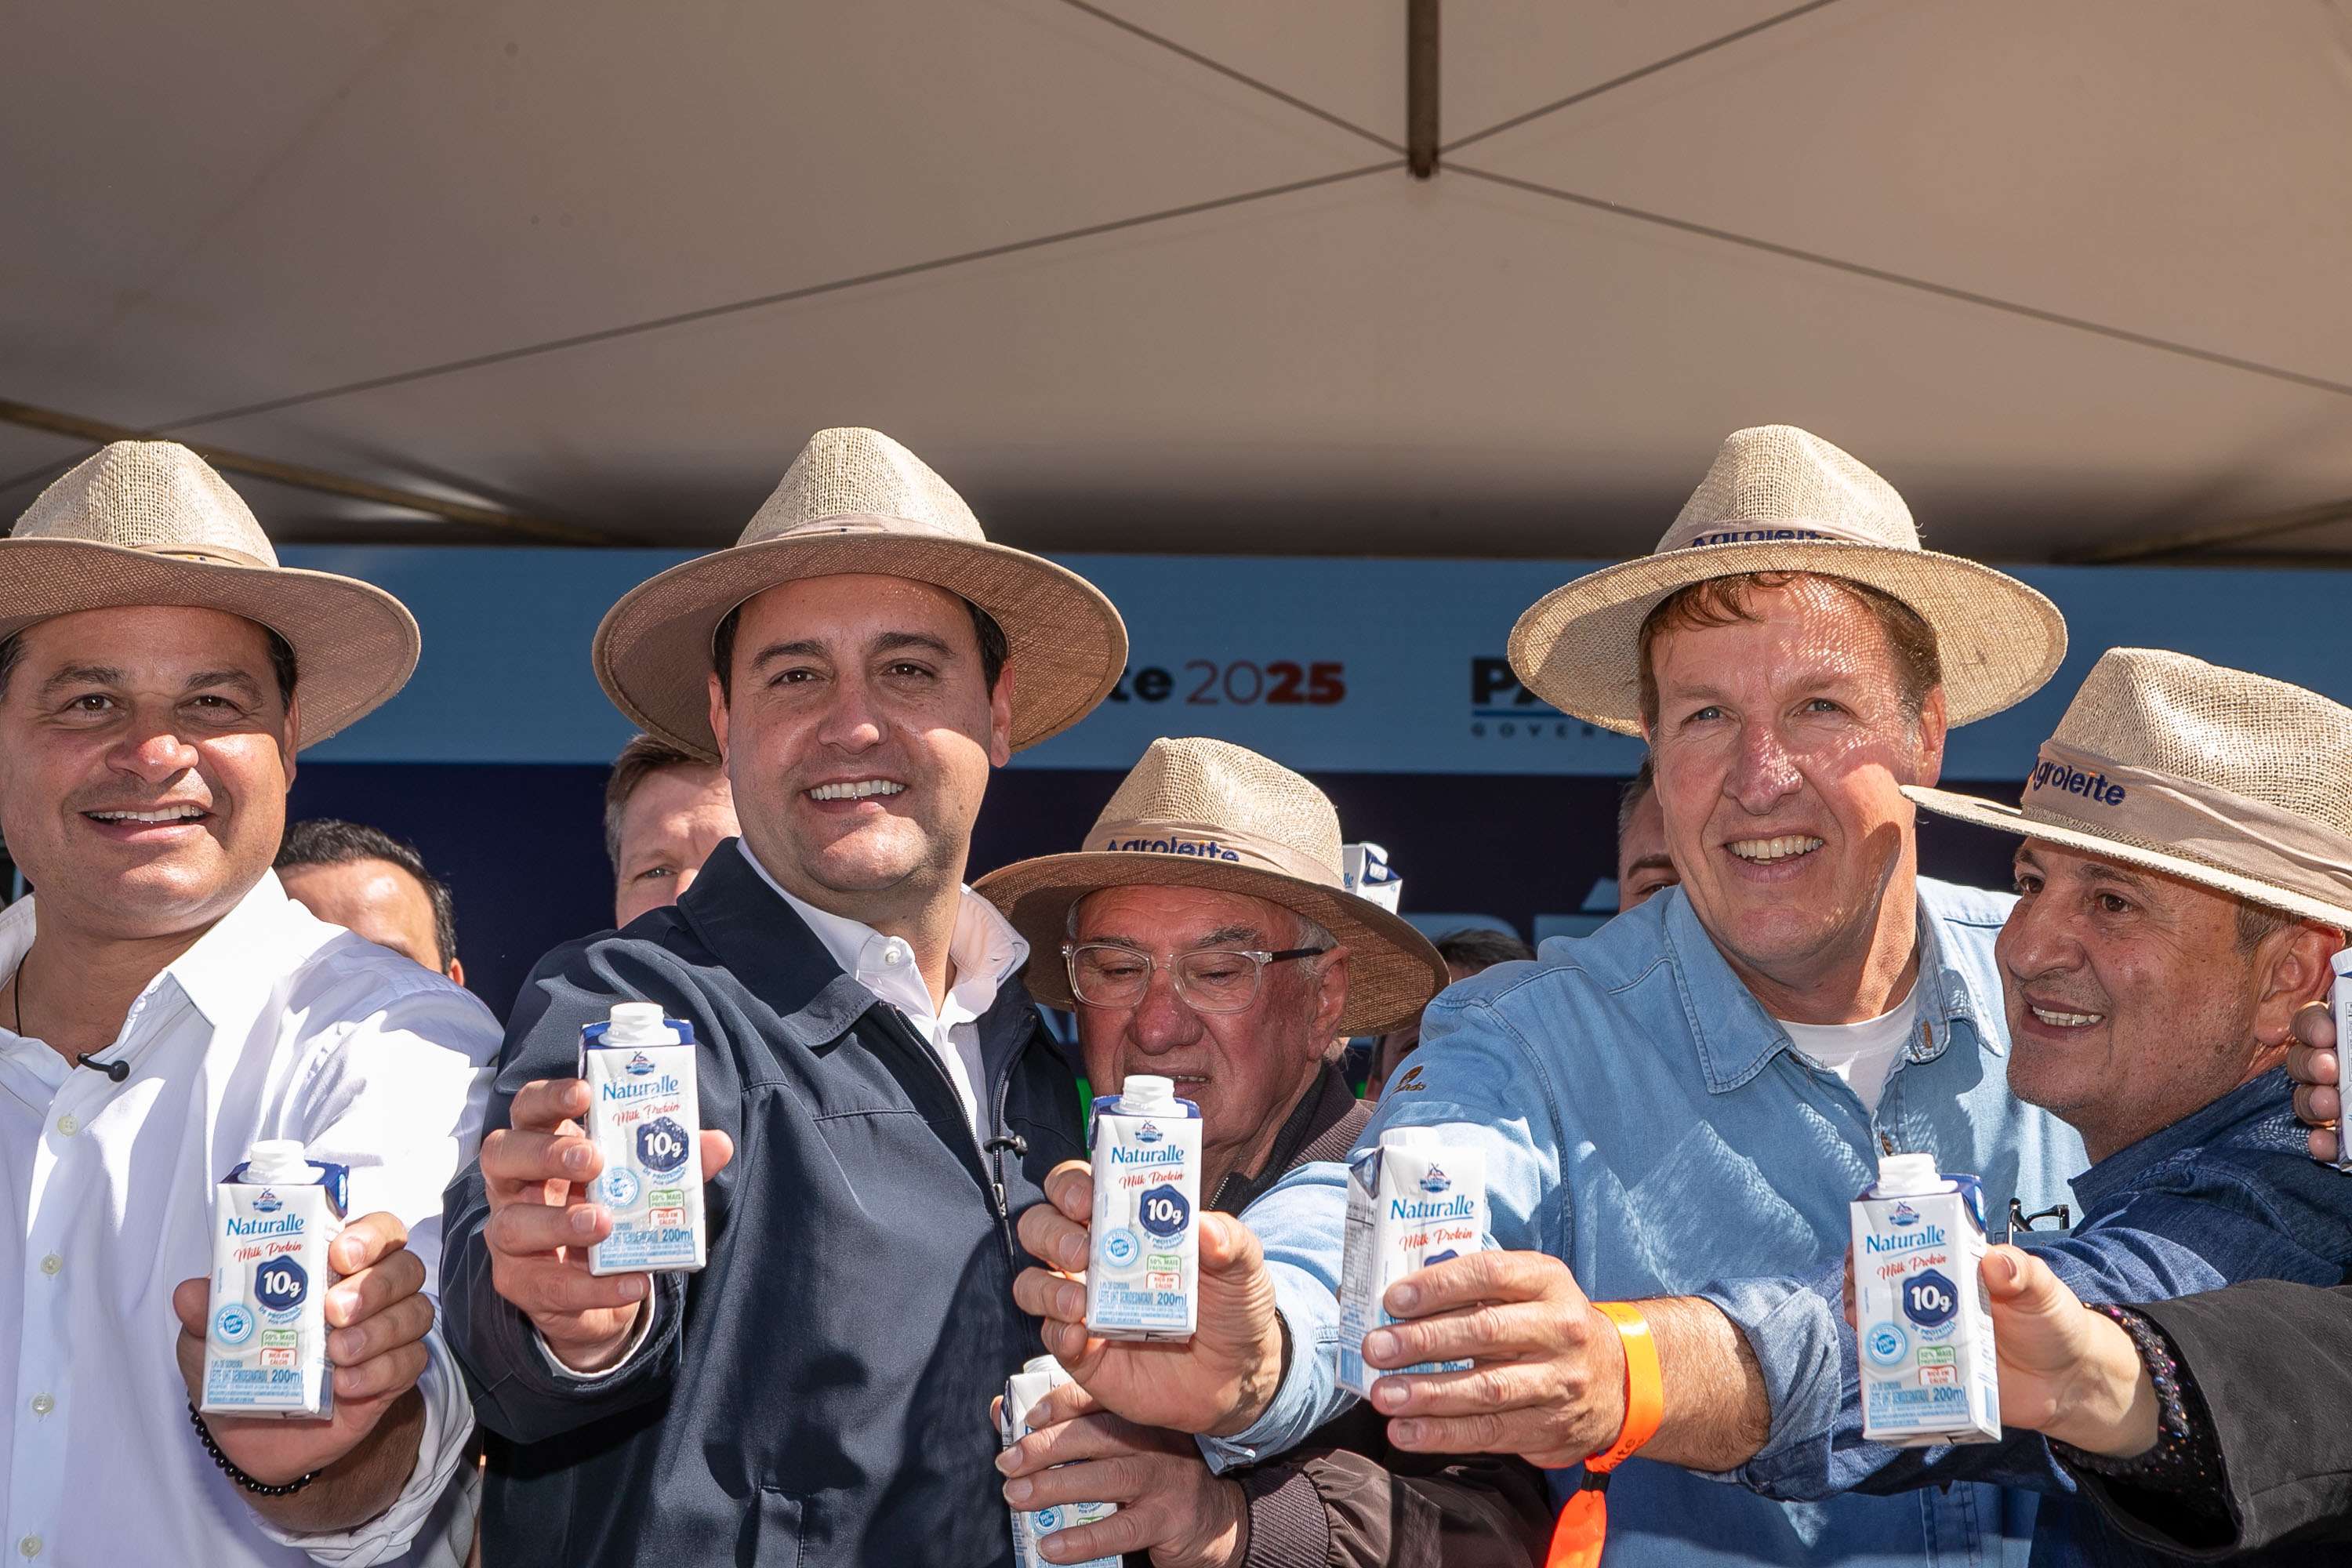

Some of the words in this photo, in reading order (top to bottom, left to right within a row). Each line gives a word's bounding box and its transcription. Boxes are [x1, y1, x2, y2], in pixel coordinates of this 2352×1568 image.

[1185, 659, 1345, 705] 2025
[1471, 722, 1624, 738] GOVER
[602, 1075, 679, 1102] Naturalle
[612, 1111, 640, 1127] Milk
[644, 1102, 681, 1120] Protein
[644, 1130, 684, 1158] 10g
[1111, 1145, 1185, 1164] Naturalle
[1119, 1175, 1145, 1190] Milk
[1149, 1171, 1184, 1185] Protein
[1148, 1198, 1183, 1225] 10g
[1391, 1195, 1474, 1219] Naturalle
[226, 1214, 304, 1236] Naturalle
[662, 1228, 693, 1242] 200ml
[1399, 1232, 1428, 1252] Milk
[1434, 1229, 1473, 1246] Protein
[1866, 1225, 1945, 1254] Naturalle
[234, 1245, 262, 1263] Milk
[266, 1242, 303, 1256] Protein
[1877, 1263, 1905, 1280] Milk
[1909, 1254, 1946, 1272] Protein
[263, 1270, 302, 1298] 10g
[1157, 1292, 1187, 1306] 200ml
[1911, 1286, 1951, 1313] 10g
[272, 1369, 303, 1383] 200ml
[1933, 1385, 1966, 1402] 200ml
